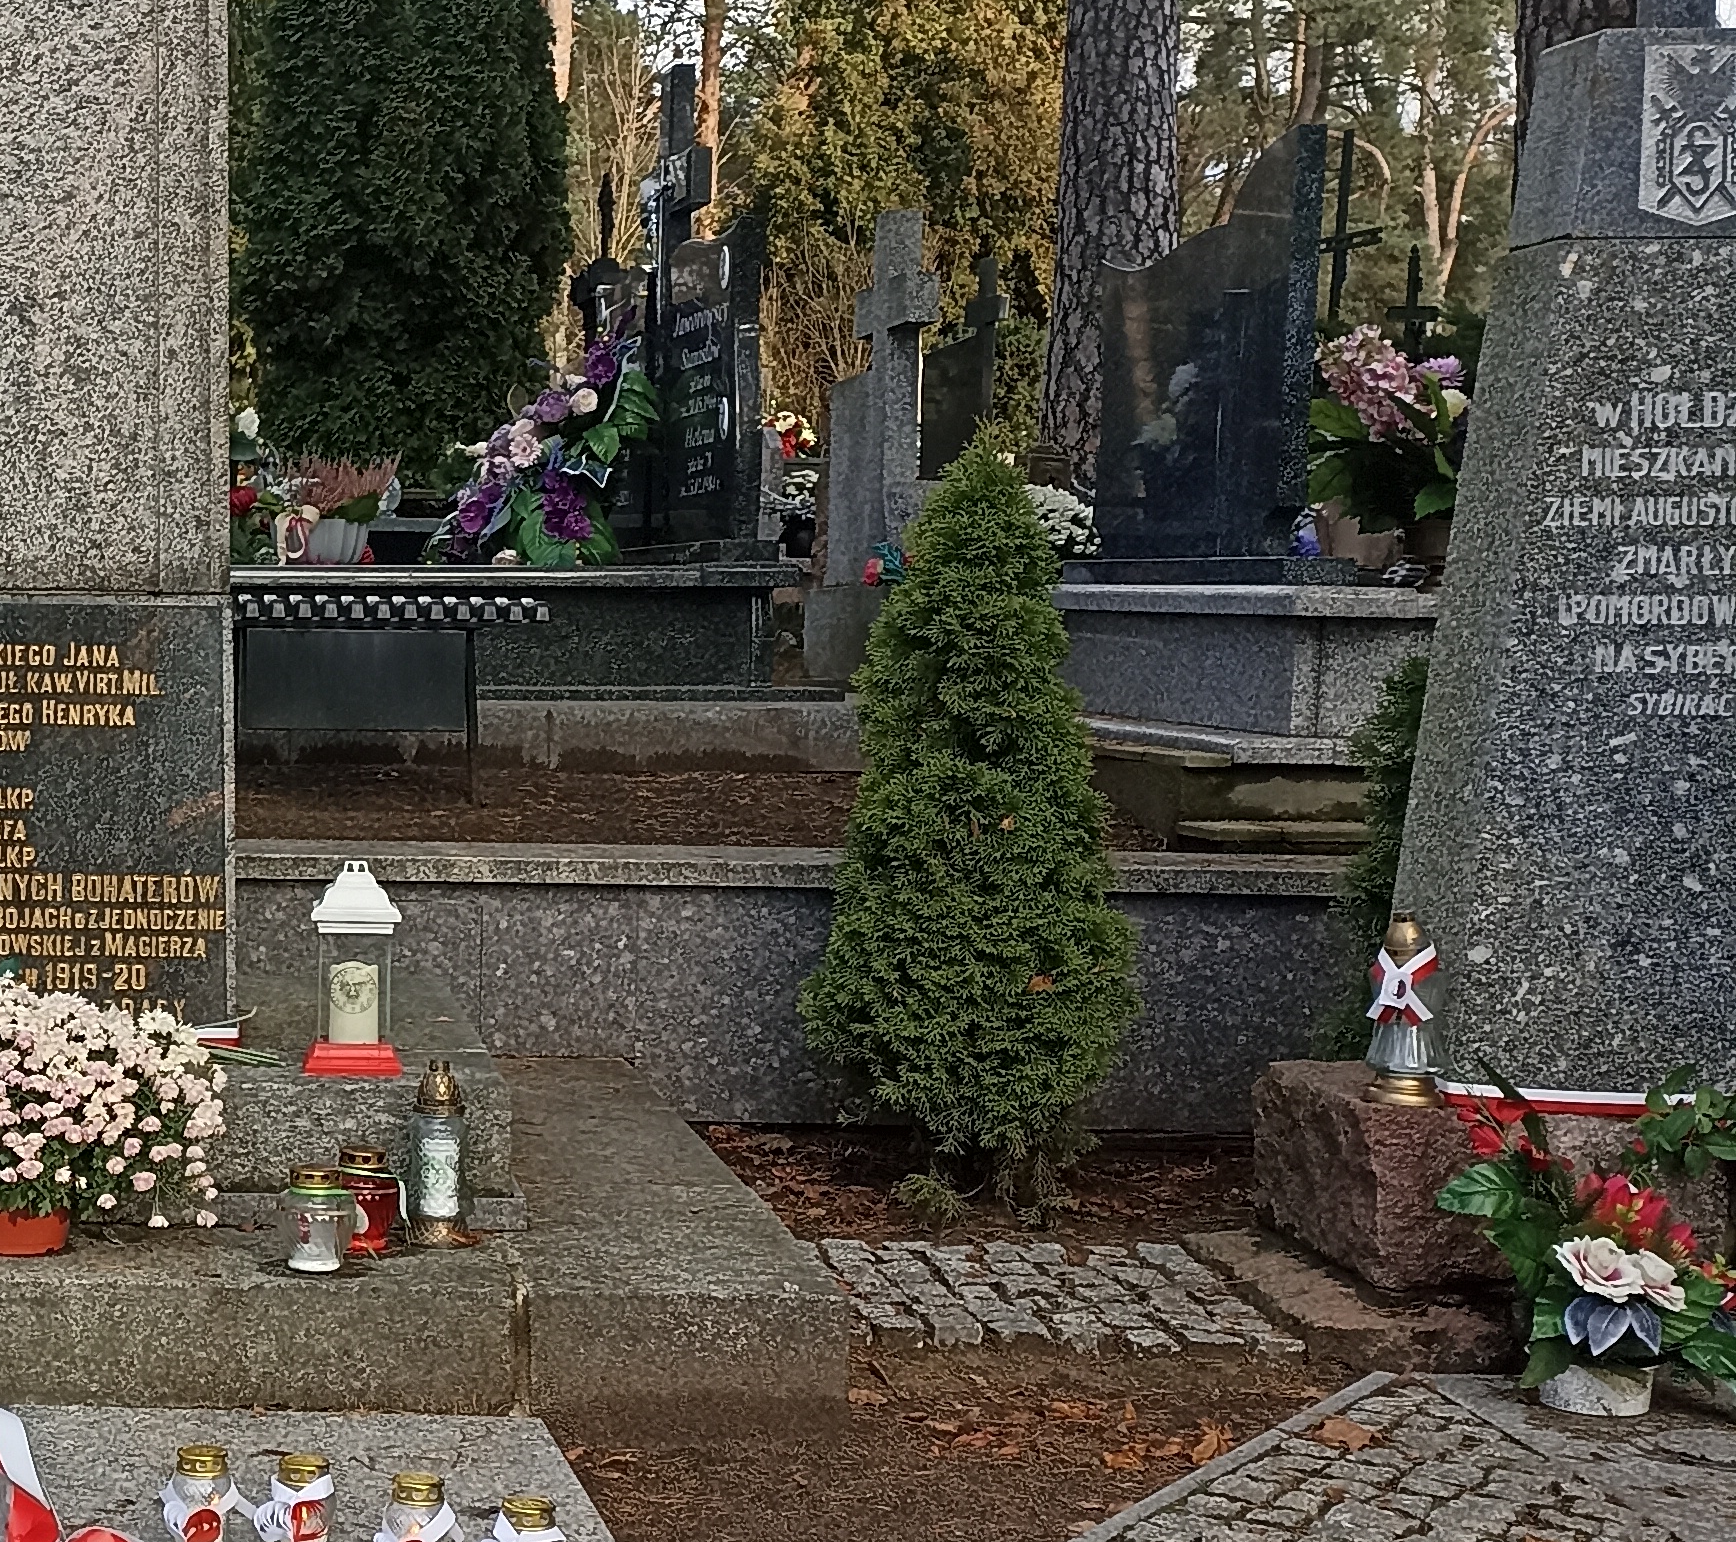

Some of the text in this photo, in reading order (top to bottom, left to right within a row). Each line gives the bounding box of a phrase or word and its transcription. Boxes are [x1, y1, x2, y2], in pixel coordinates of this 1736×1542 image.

[1543, 497, 1622, 526] ZIEMI
[63, 641, 120, 668] JANA
[42, 699, 136, 725] HENRYKA
[71, 870, 220, 903] BOHATERÓW
